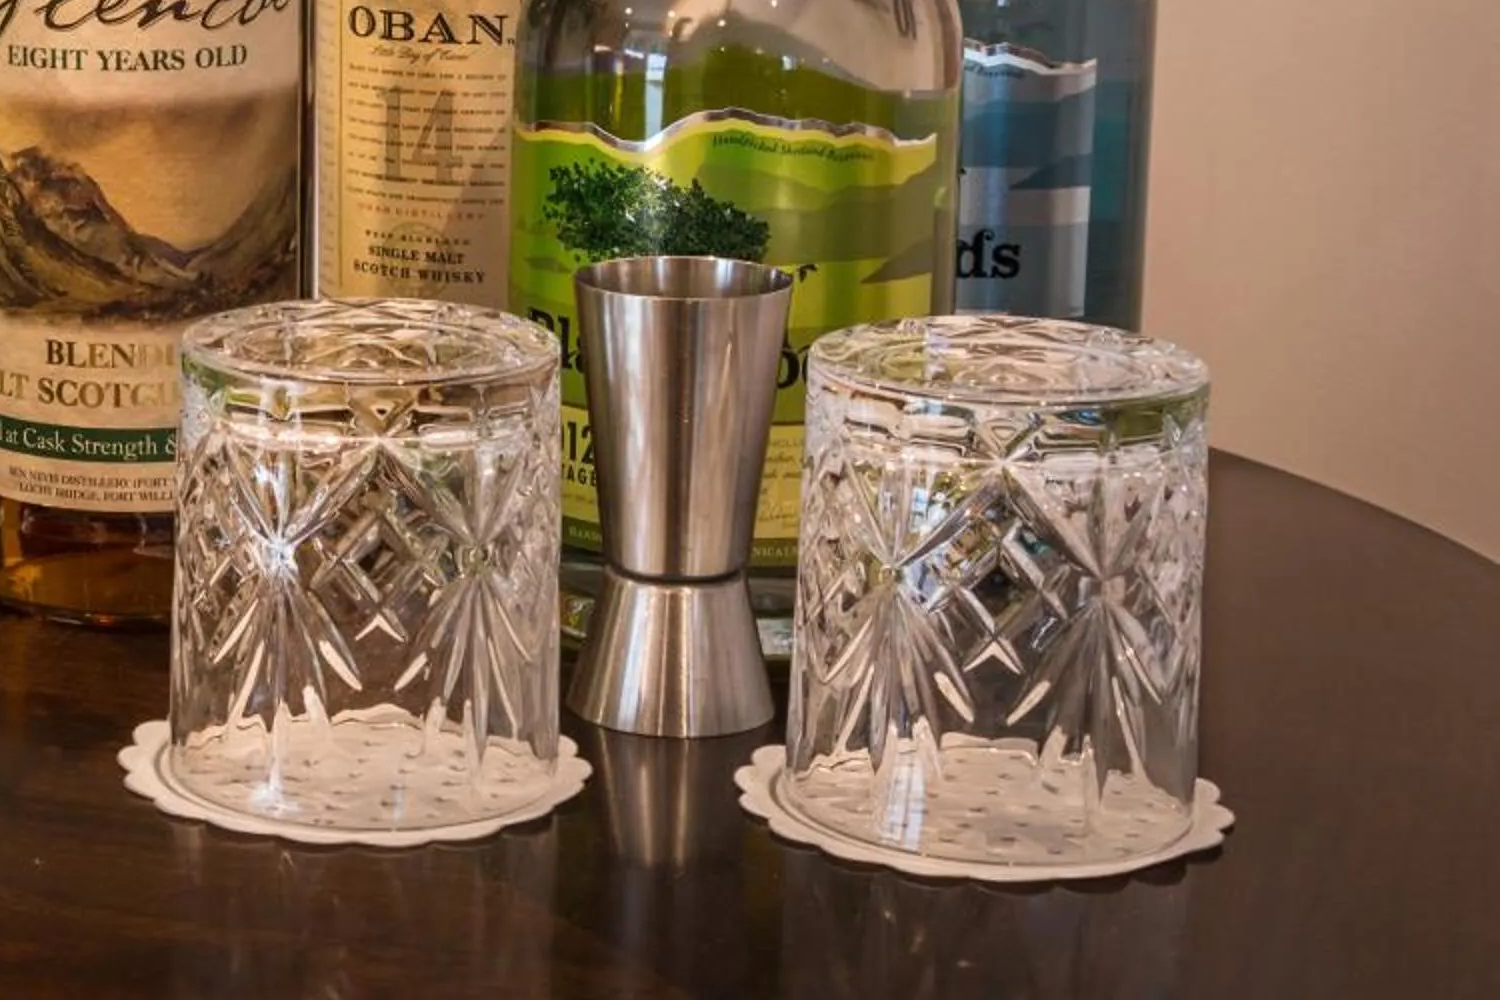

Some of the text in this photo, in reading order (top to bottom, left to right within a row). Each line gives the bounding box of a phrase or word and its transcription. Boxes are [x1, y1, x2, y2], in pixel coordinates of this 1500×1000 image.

[347, 4, 510, 47] OBAN
[7, 42, 248, 72] EIGHT YEARS OLD
[368, 245, 466, 265] SINGLE MALT
[353, 258, 486, 285] SCOTCH WHISKY
[45, 338, 176, 369] BLEND
[5, 428, 19, 445] at
[23, 427, 66, 452] Cask
[71, 434, 157, 461] Strength
